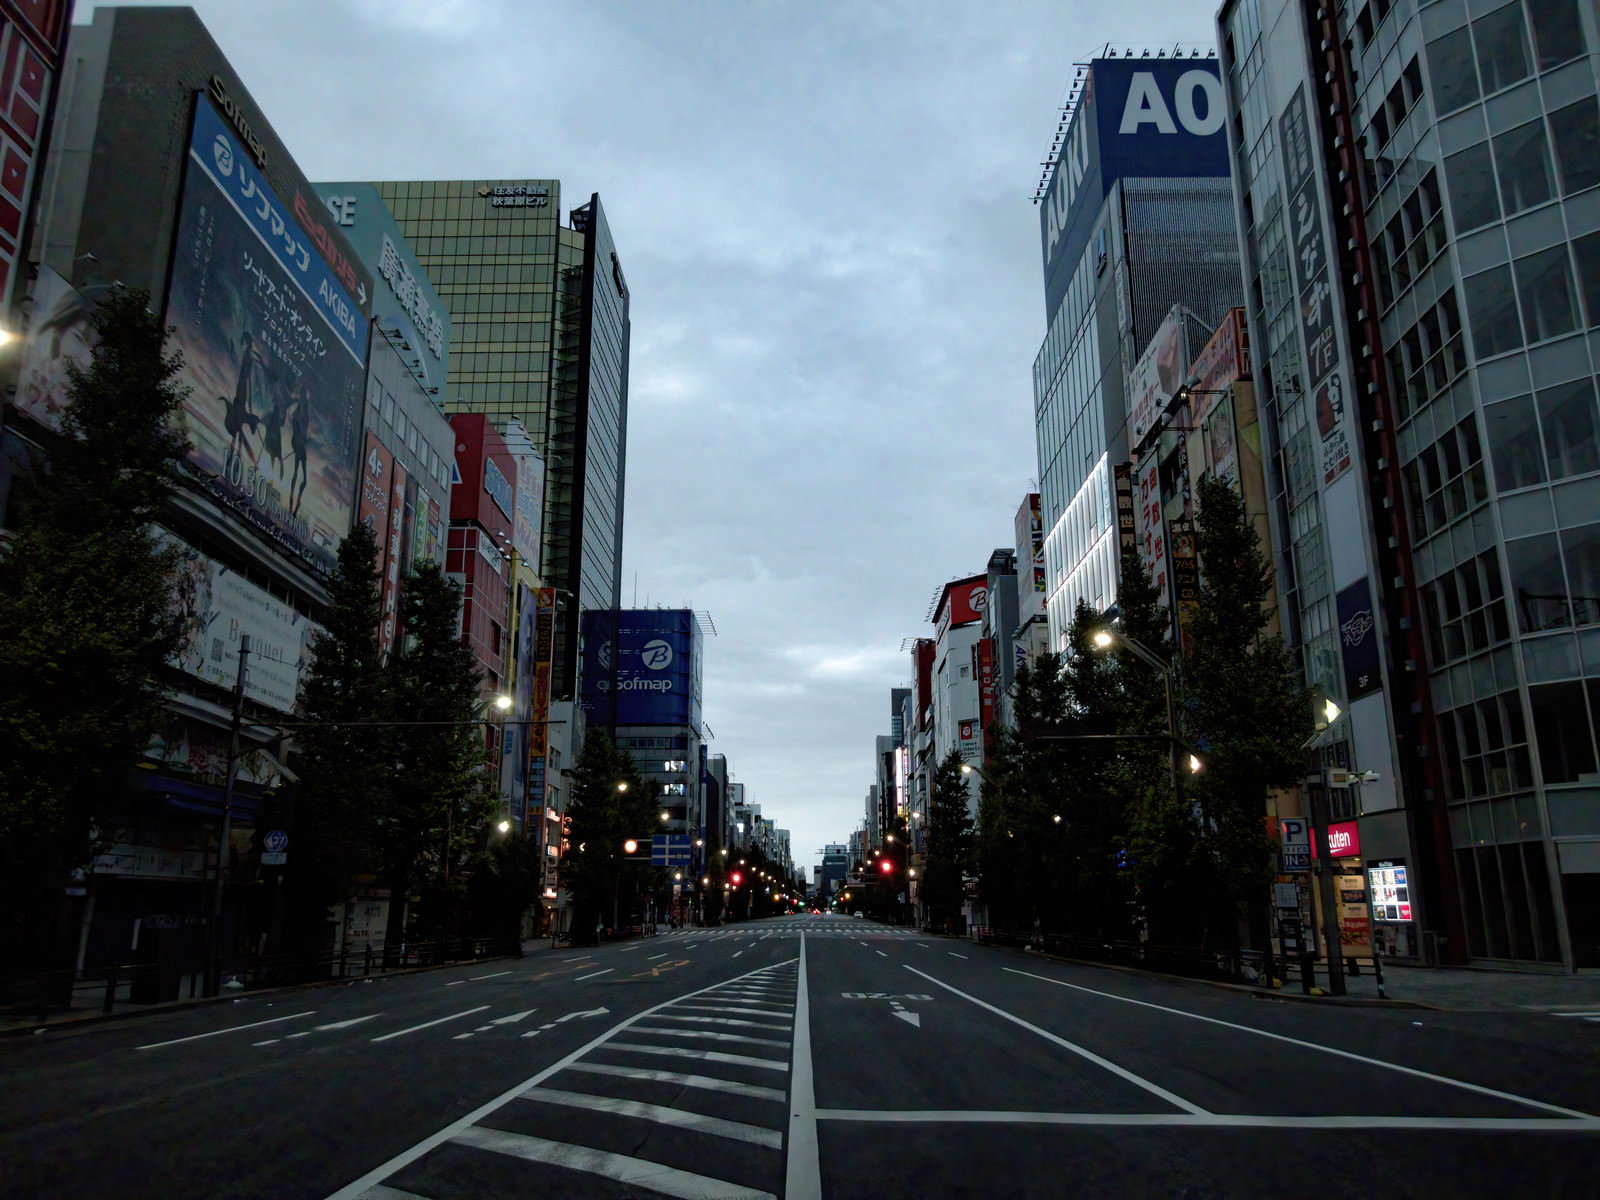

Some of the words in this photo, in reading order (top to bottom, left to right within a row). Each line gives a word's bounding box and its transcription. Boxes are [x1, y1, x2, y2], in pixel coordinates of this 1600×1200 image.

[208, 75, 268, 168] Sofmap
[1118, 69, 1225, 136] AO
[239, 162, 309, 273] ソフマップ
[1046, 106, 1090, 264] AOKI
[319, 277, 358, 340] AKIBA
[1286, 822, 1302, 842] P
[1286, 853, 1299, 866] IN
